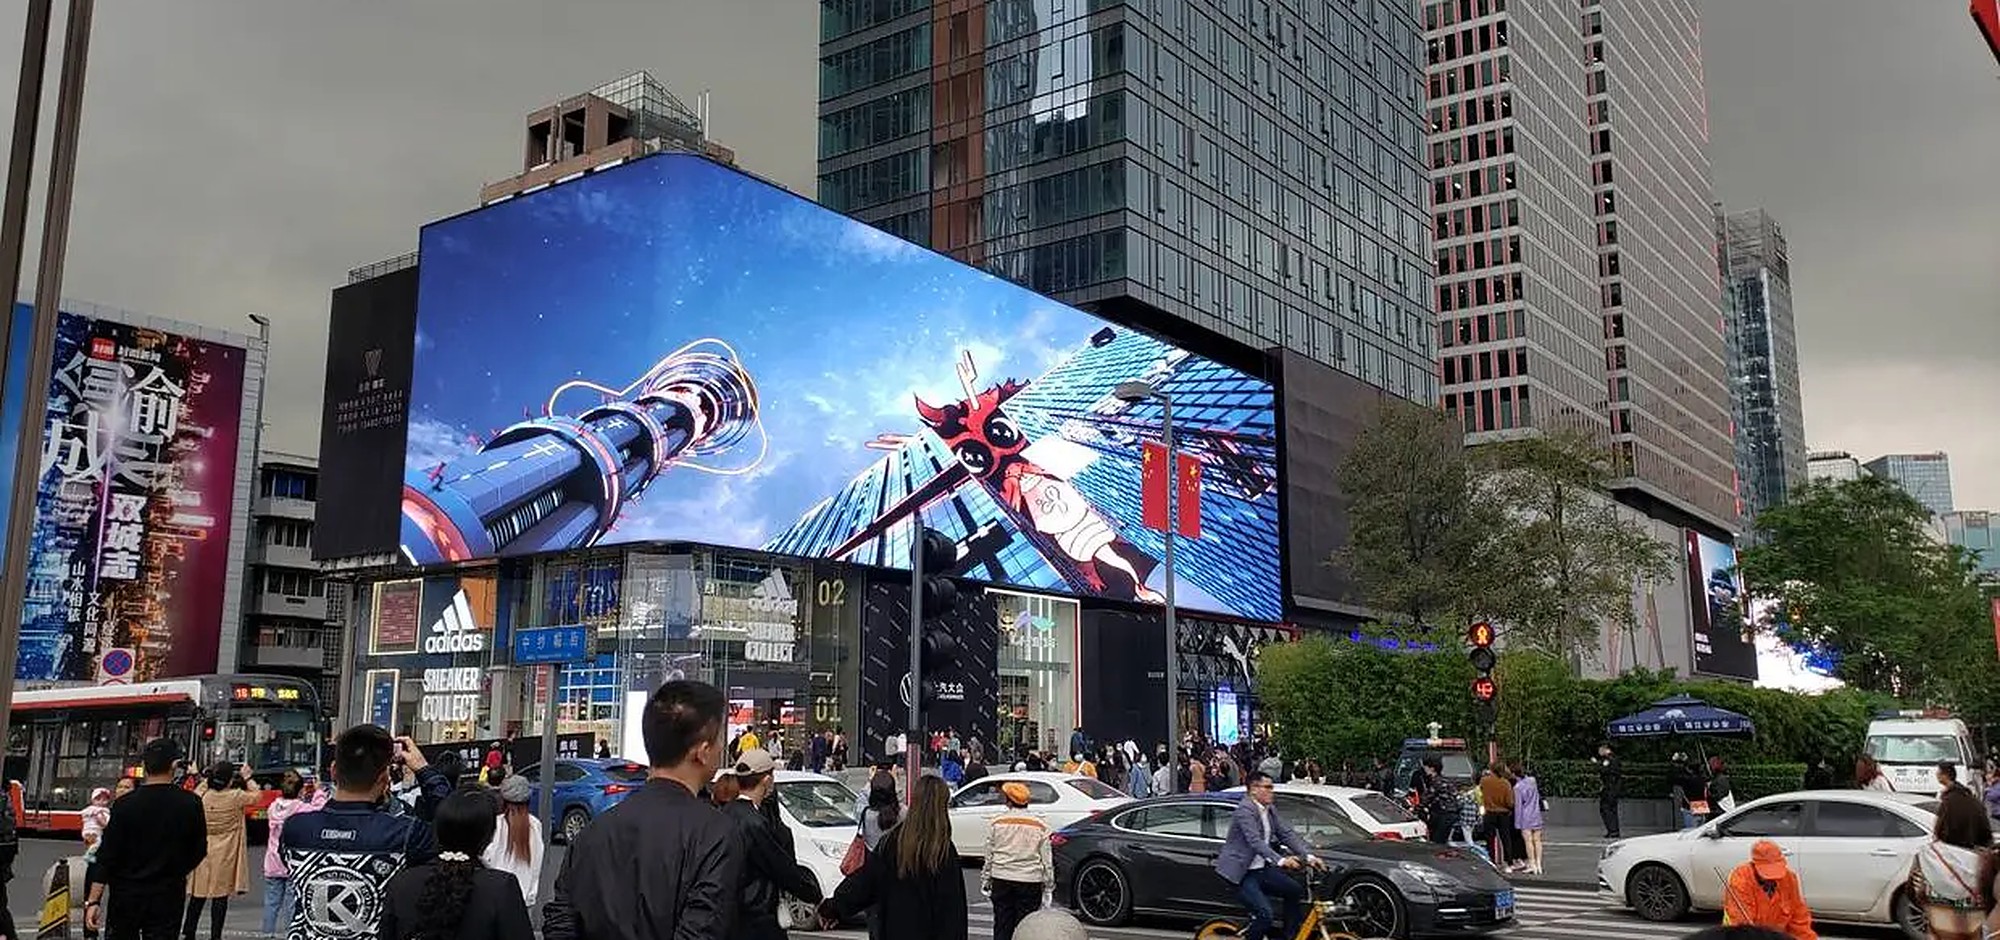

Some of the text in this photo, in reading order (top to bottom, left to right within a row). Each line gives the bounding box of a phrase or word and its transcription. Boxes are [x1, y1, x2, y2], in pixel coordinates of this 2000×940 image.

[818, 578, 845, 606] 02
[424, 630, 484, 654] adidas
[744, 640, 796, 662] COLLECT
[422, 667, 481, 693] SNEAKER
[421, 694, 477, 722] COLLECT
[815, 696, 841, 722] 01
